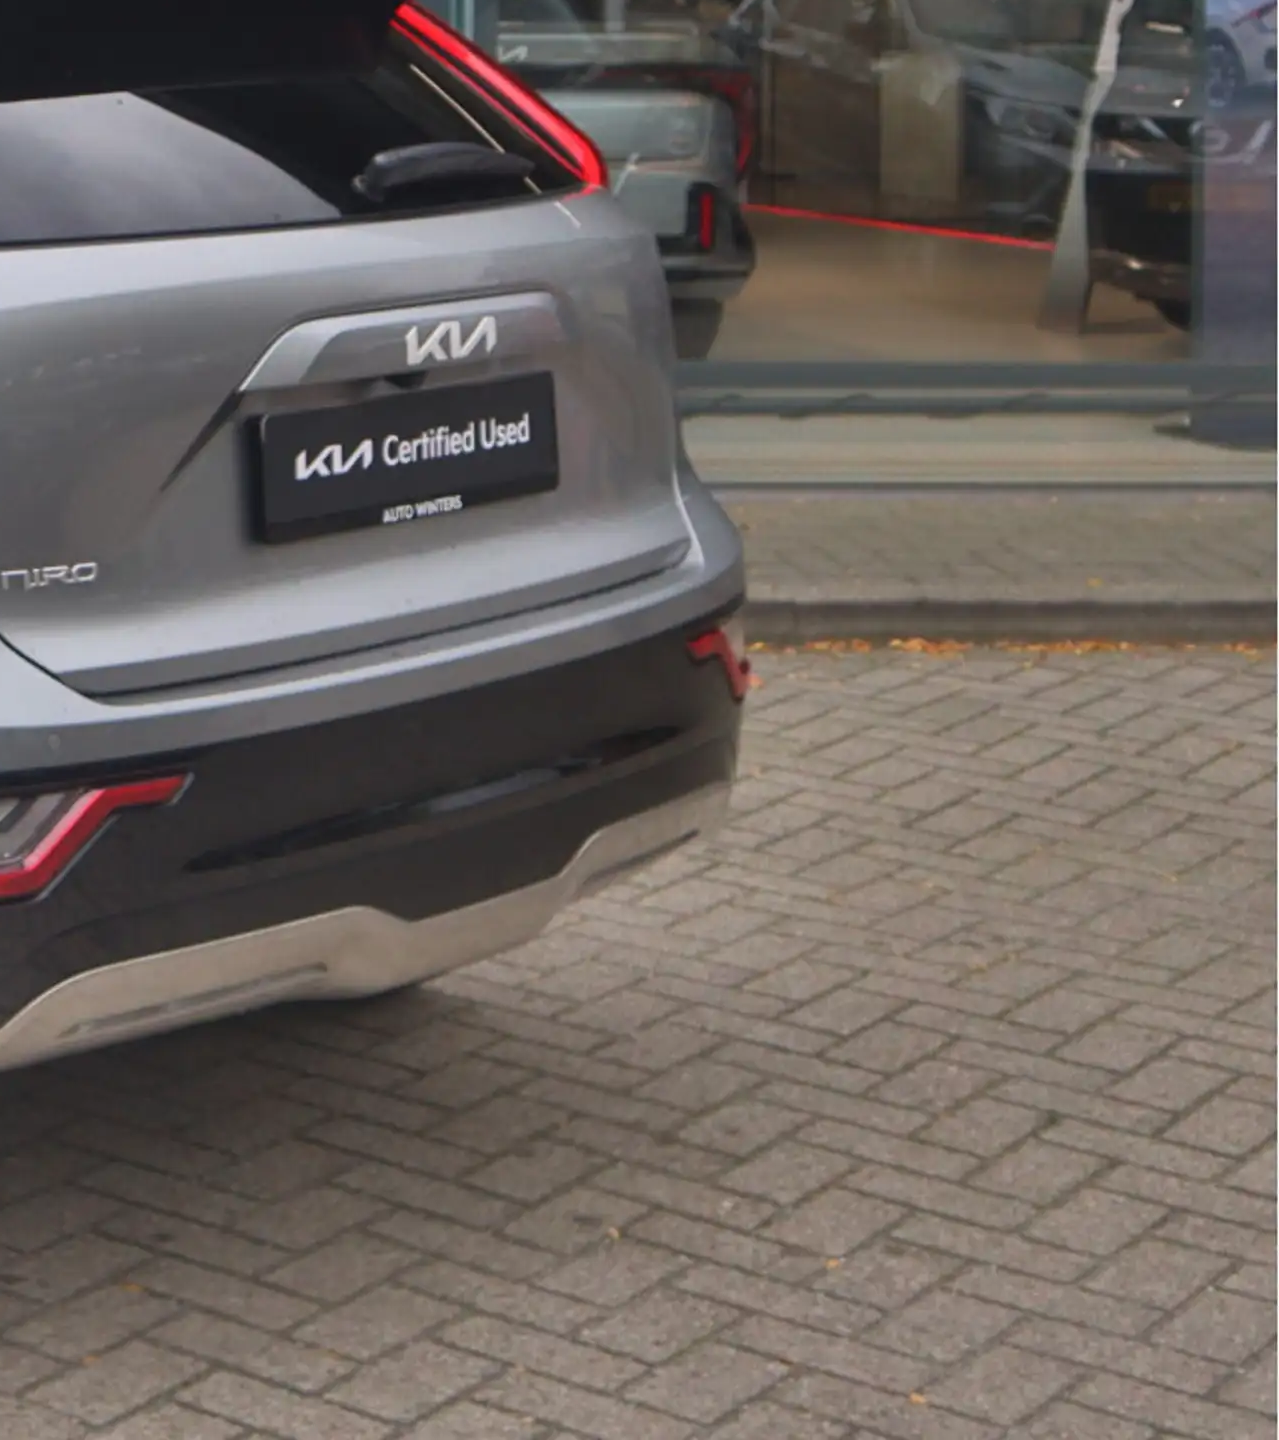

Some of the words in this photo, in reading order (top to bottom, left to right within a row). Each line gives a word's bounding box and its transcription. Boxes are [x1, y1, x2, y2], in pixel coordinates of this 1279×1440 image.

[404, 315, 497, 366] KIA
[294, 438, 374, 481] KIA
[381, 422, 476, 467] Certified
[478, 412, 531, 452] Used
[382, 503, 414, 524] AUTO
[415, 494, 464, 517] WINTERS
[0, 562, 98, 592] NIRO
